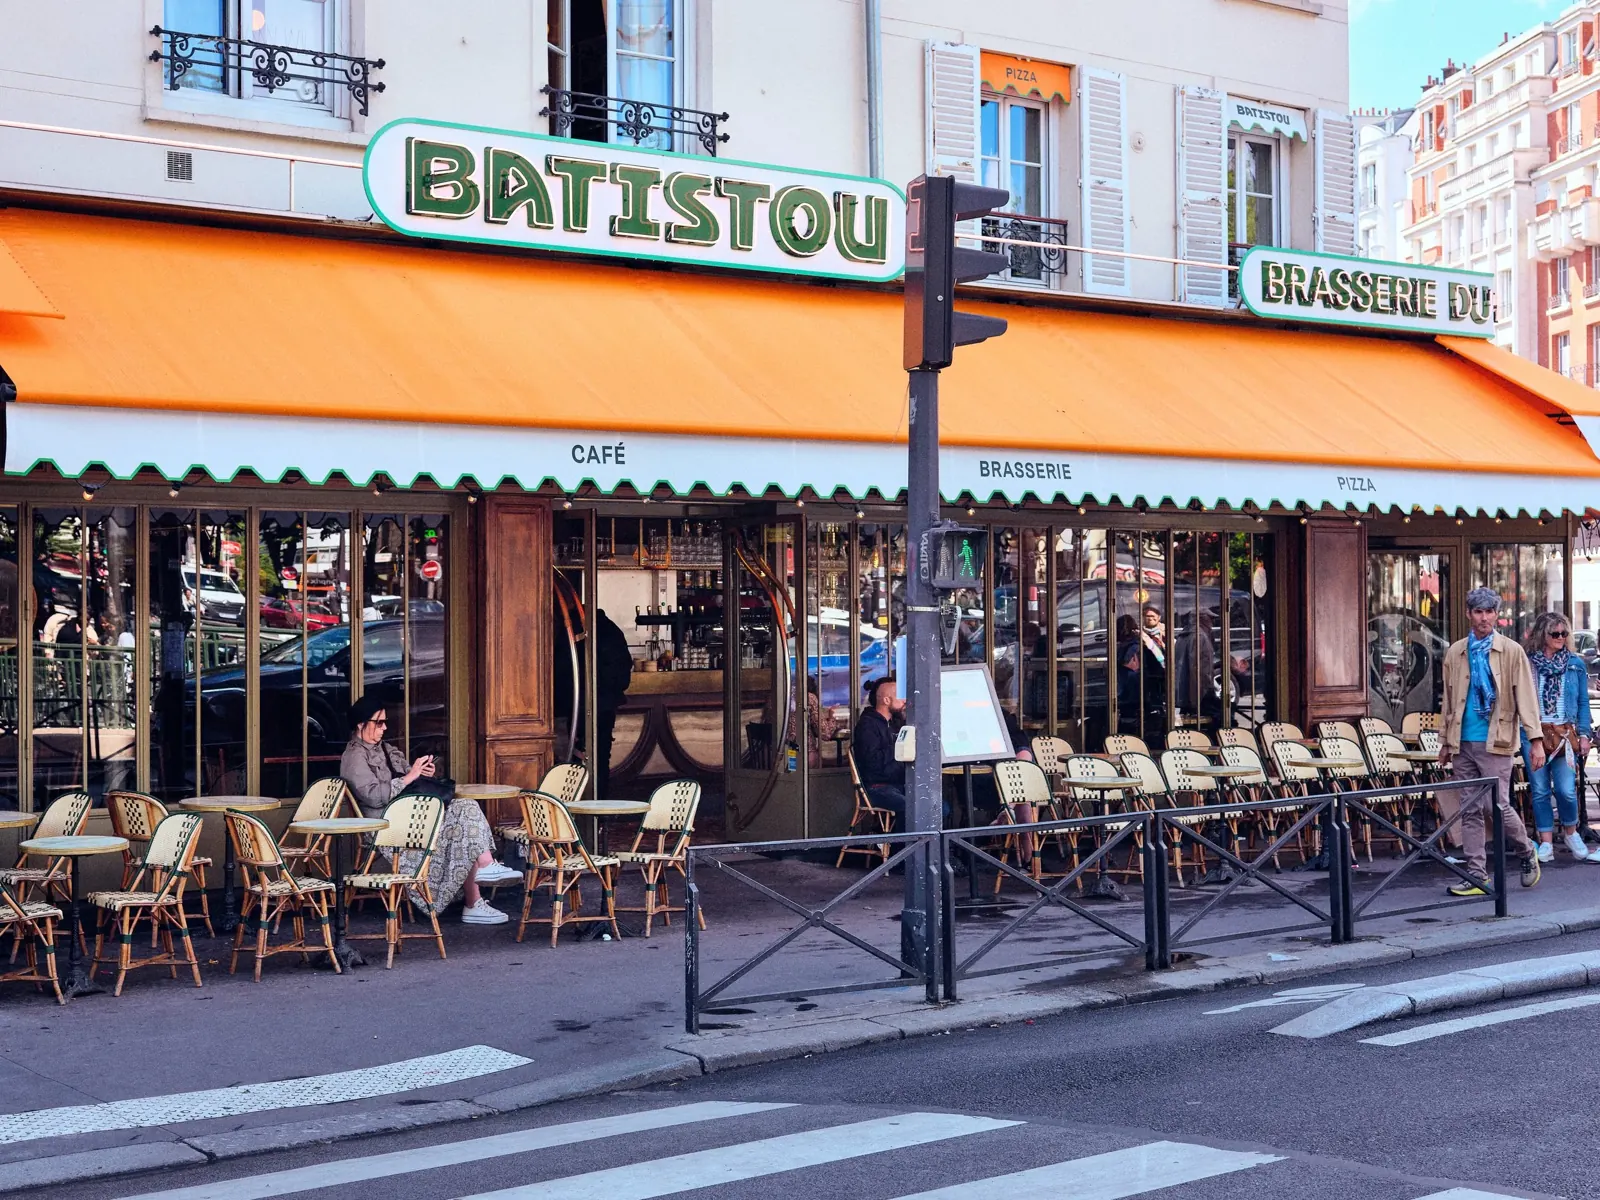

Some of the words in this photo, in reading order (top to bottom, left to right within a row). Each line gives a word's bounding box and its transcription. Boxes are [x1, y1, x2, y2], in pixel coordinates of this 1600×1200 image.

[1005, 67, 1038, 83] PIZZA
[1236, 104, 1290, 125] BATISTOU
[405, 137, 889, 265] BATISTOU
[1261, 260, 1438, 319] BRASSERIE
[1449, 281, 1491, 325] DU
[571, 441, 626, 465] CAFÉ
[979, 460, 1073, 480] BRASSERIE
[1336, 476, 1377, 492] PIZZA
